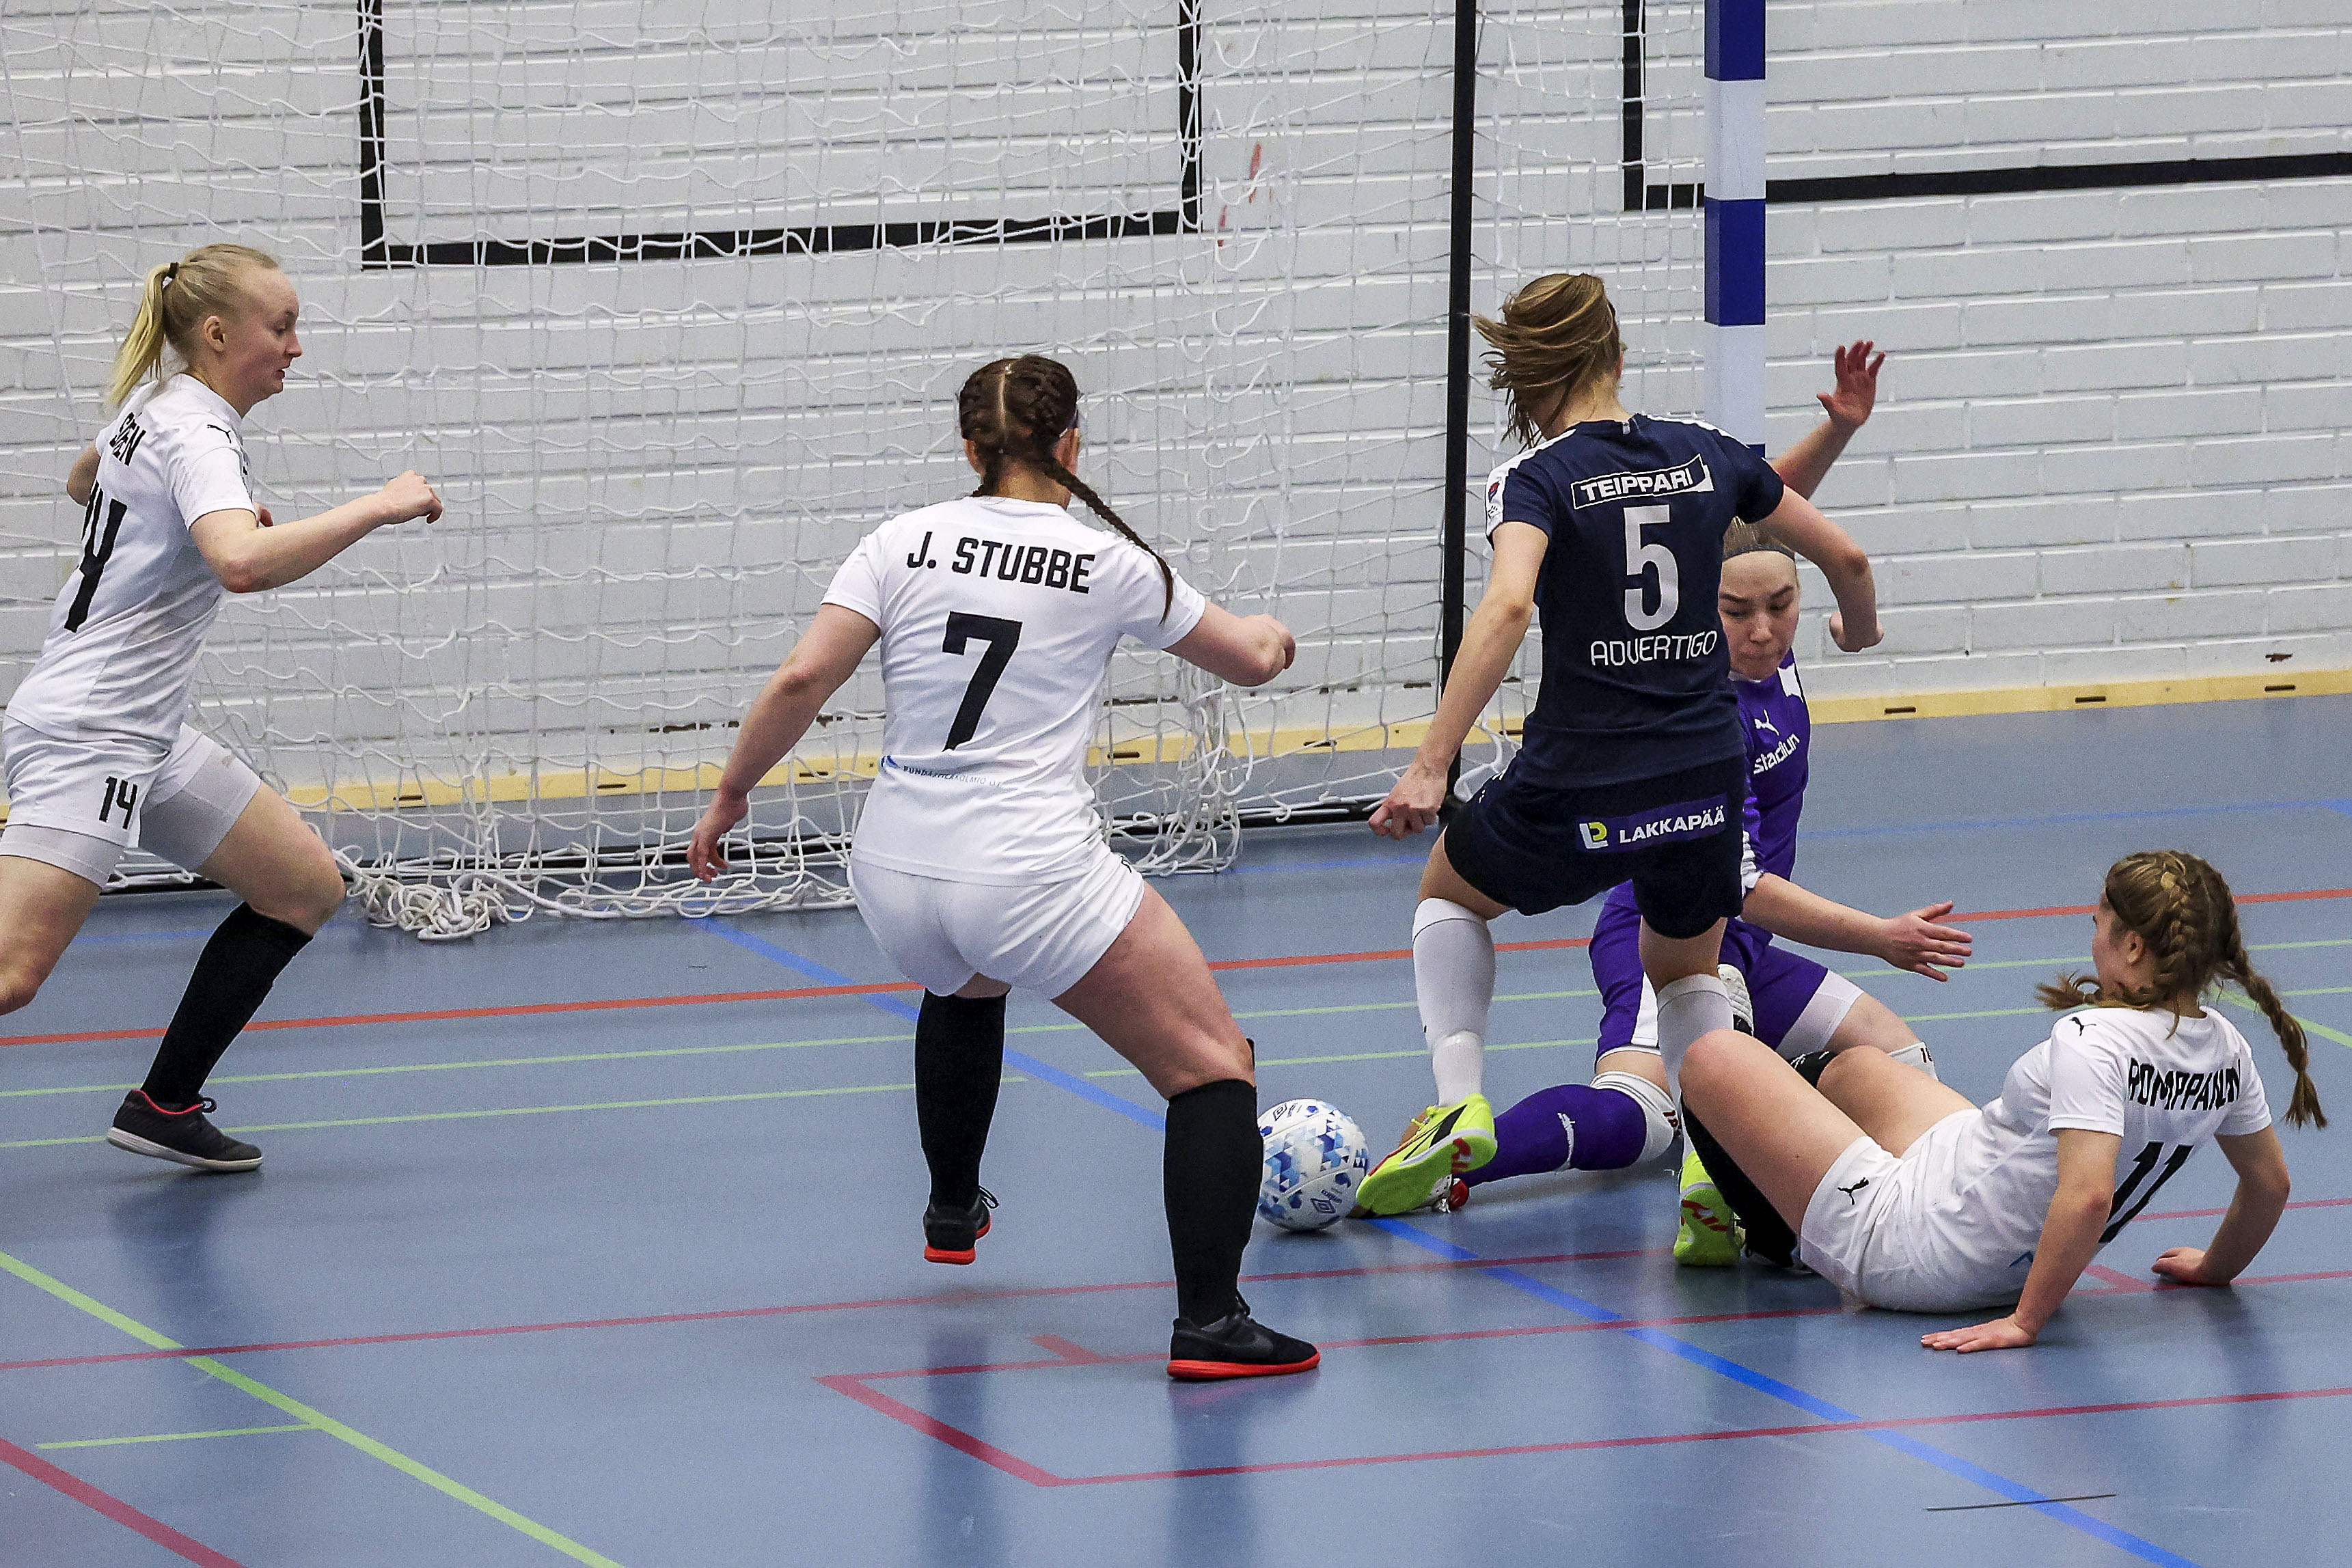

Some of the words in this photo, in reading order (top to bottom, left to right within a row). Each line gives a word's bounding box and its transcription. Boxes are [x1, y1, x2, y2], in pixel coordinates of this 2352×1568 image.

[1581, 468, 1694, 501] TEIPPARI
[907, 532, 937, 568] J.
[951, 537, 1096, 594] STUBBE
[1623, 504, 1679, 631] 5
[1590, 631, 1718, 666] ADVERTIGO
[942, 611, 1022, 752] 7
[98, 775, 138, 830] 14
[1619, 805, 1725, 844] LAKKAPÄÄ
[2098, 1141, 2195, 1243] 11
